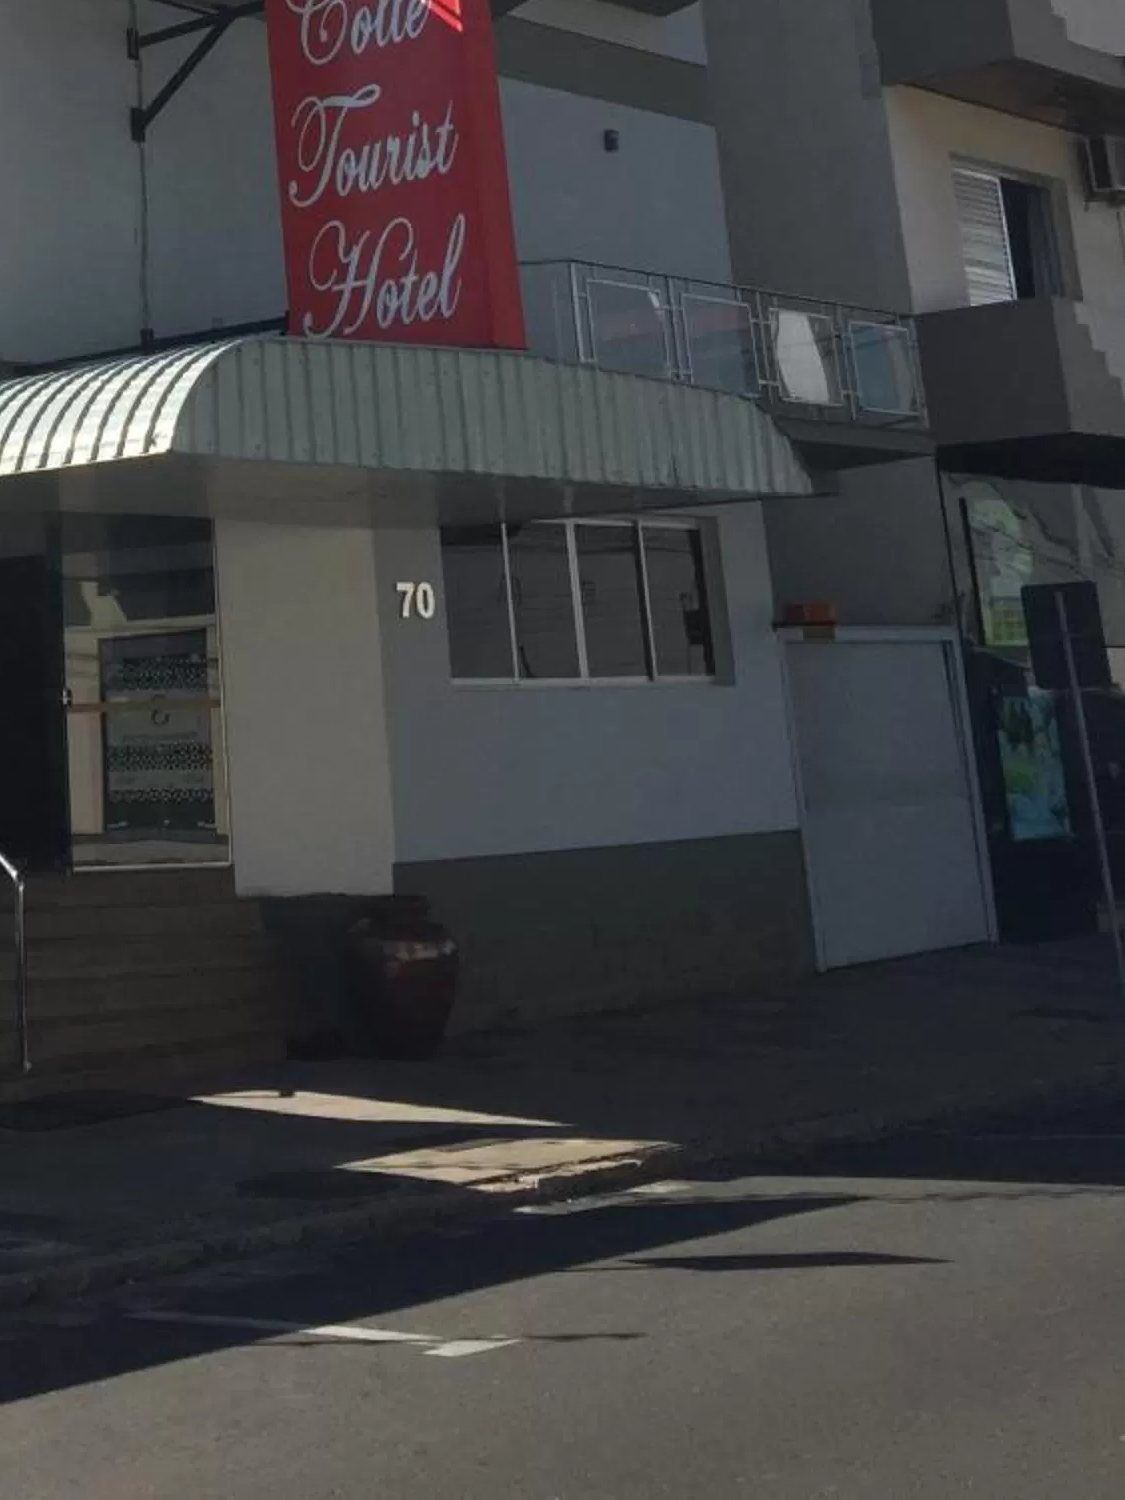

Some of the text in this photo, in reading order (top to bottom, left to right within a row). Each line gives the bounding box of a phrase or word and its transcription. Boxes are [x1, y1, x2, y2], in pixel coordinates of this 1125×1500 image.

[289, 83, 459, 208] Tourist
[303, 212, 466, 340] Hotel
[396, 581, 435, 619] 70
